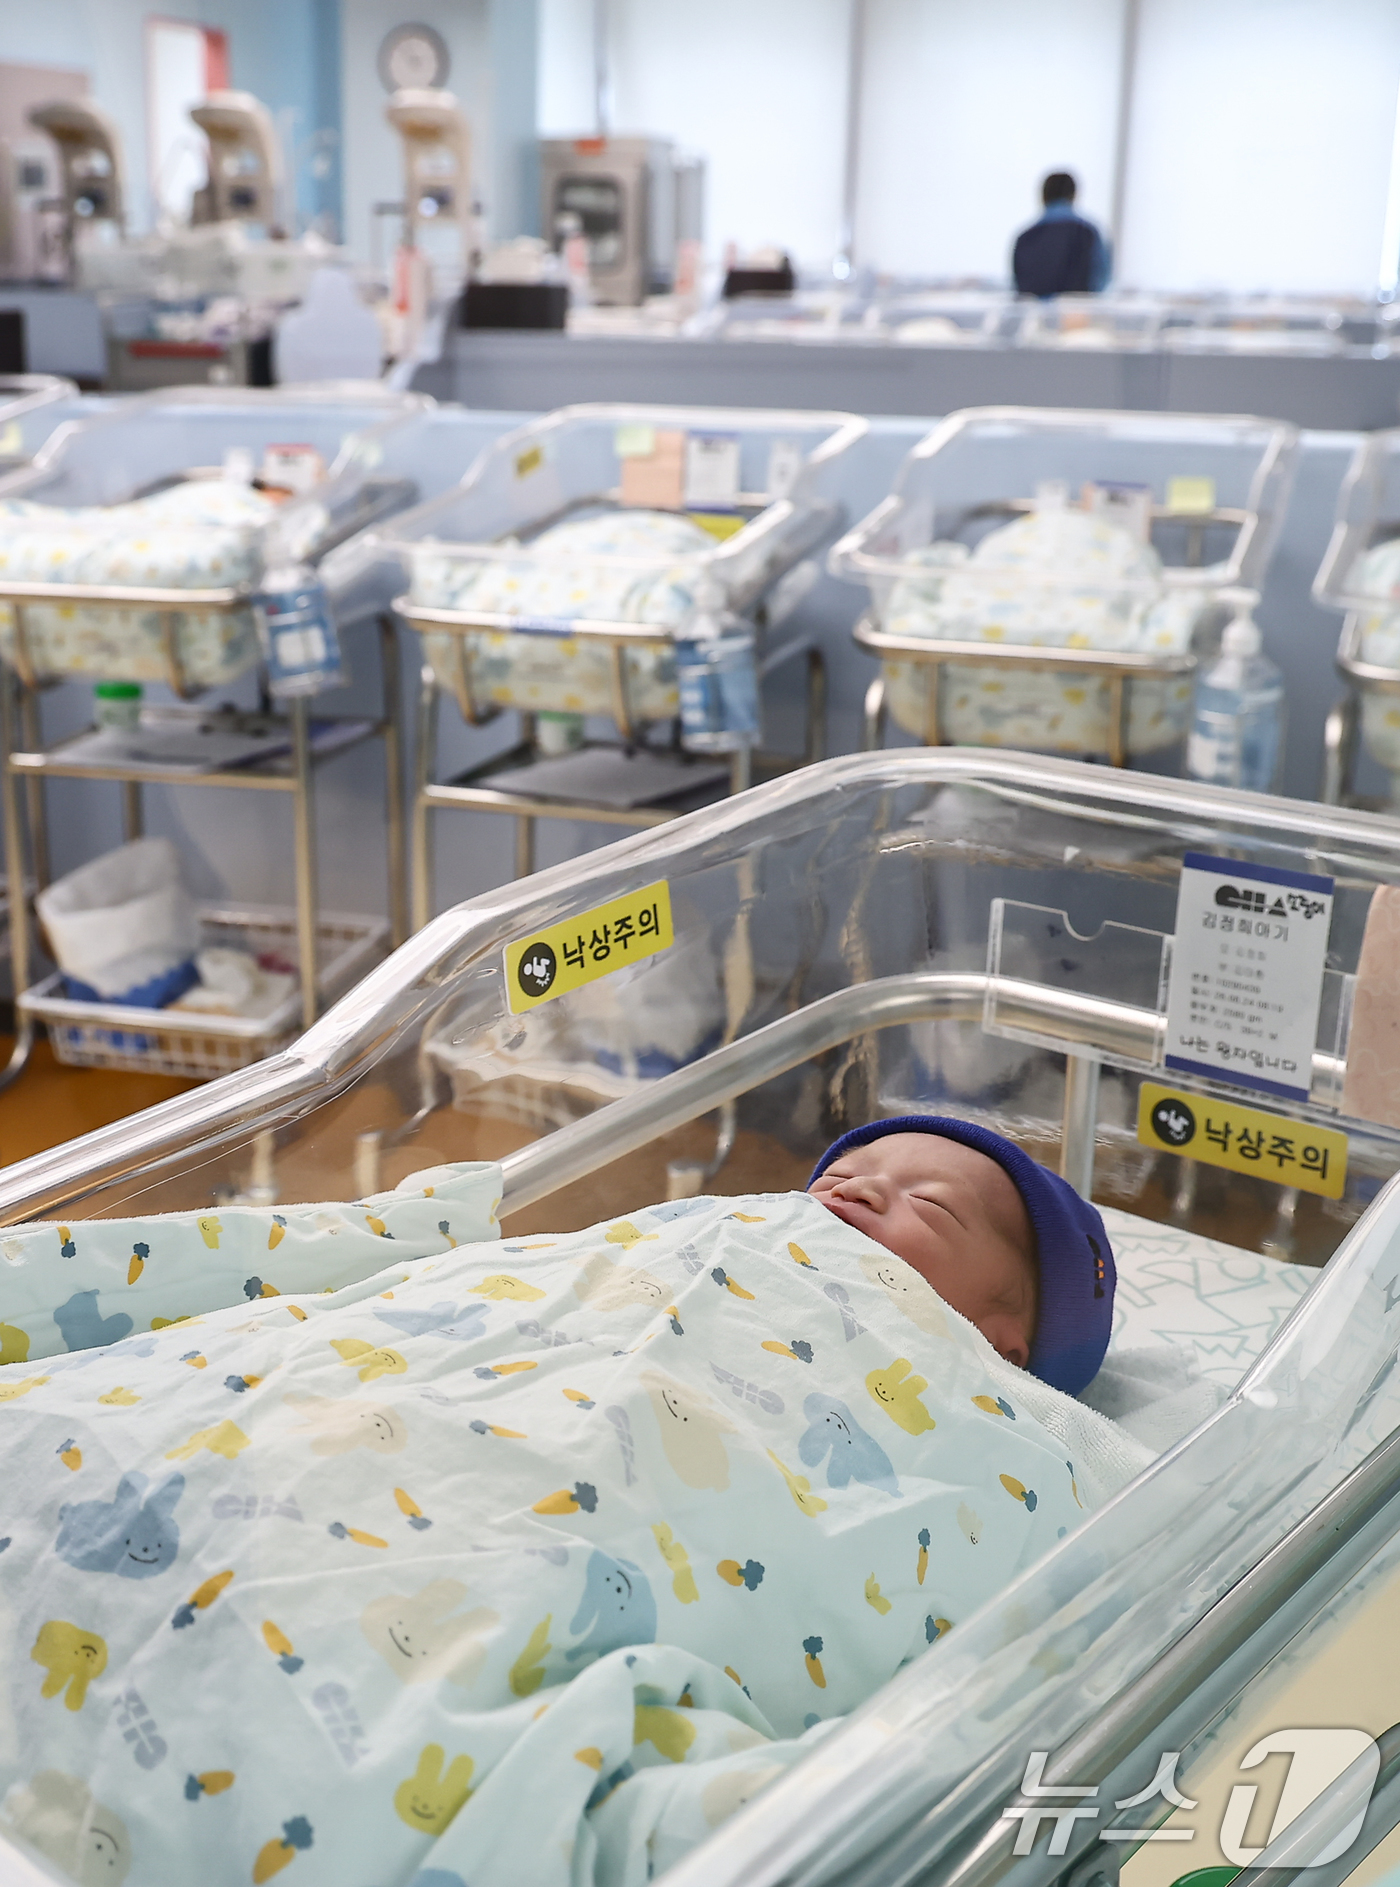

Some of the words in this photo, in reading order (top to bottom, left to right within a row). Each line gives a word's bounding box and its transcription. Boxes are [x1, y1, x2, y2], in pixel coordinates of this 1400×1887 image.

[563, 903, 660, 969] 낙상주의
[1180, 1035, 1210, 1053] 나는
[1216, 1040, 1298, 1073] 왕자입니다
[1205, 1118, 1329, 1179] 낙상주의
